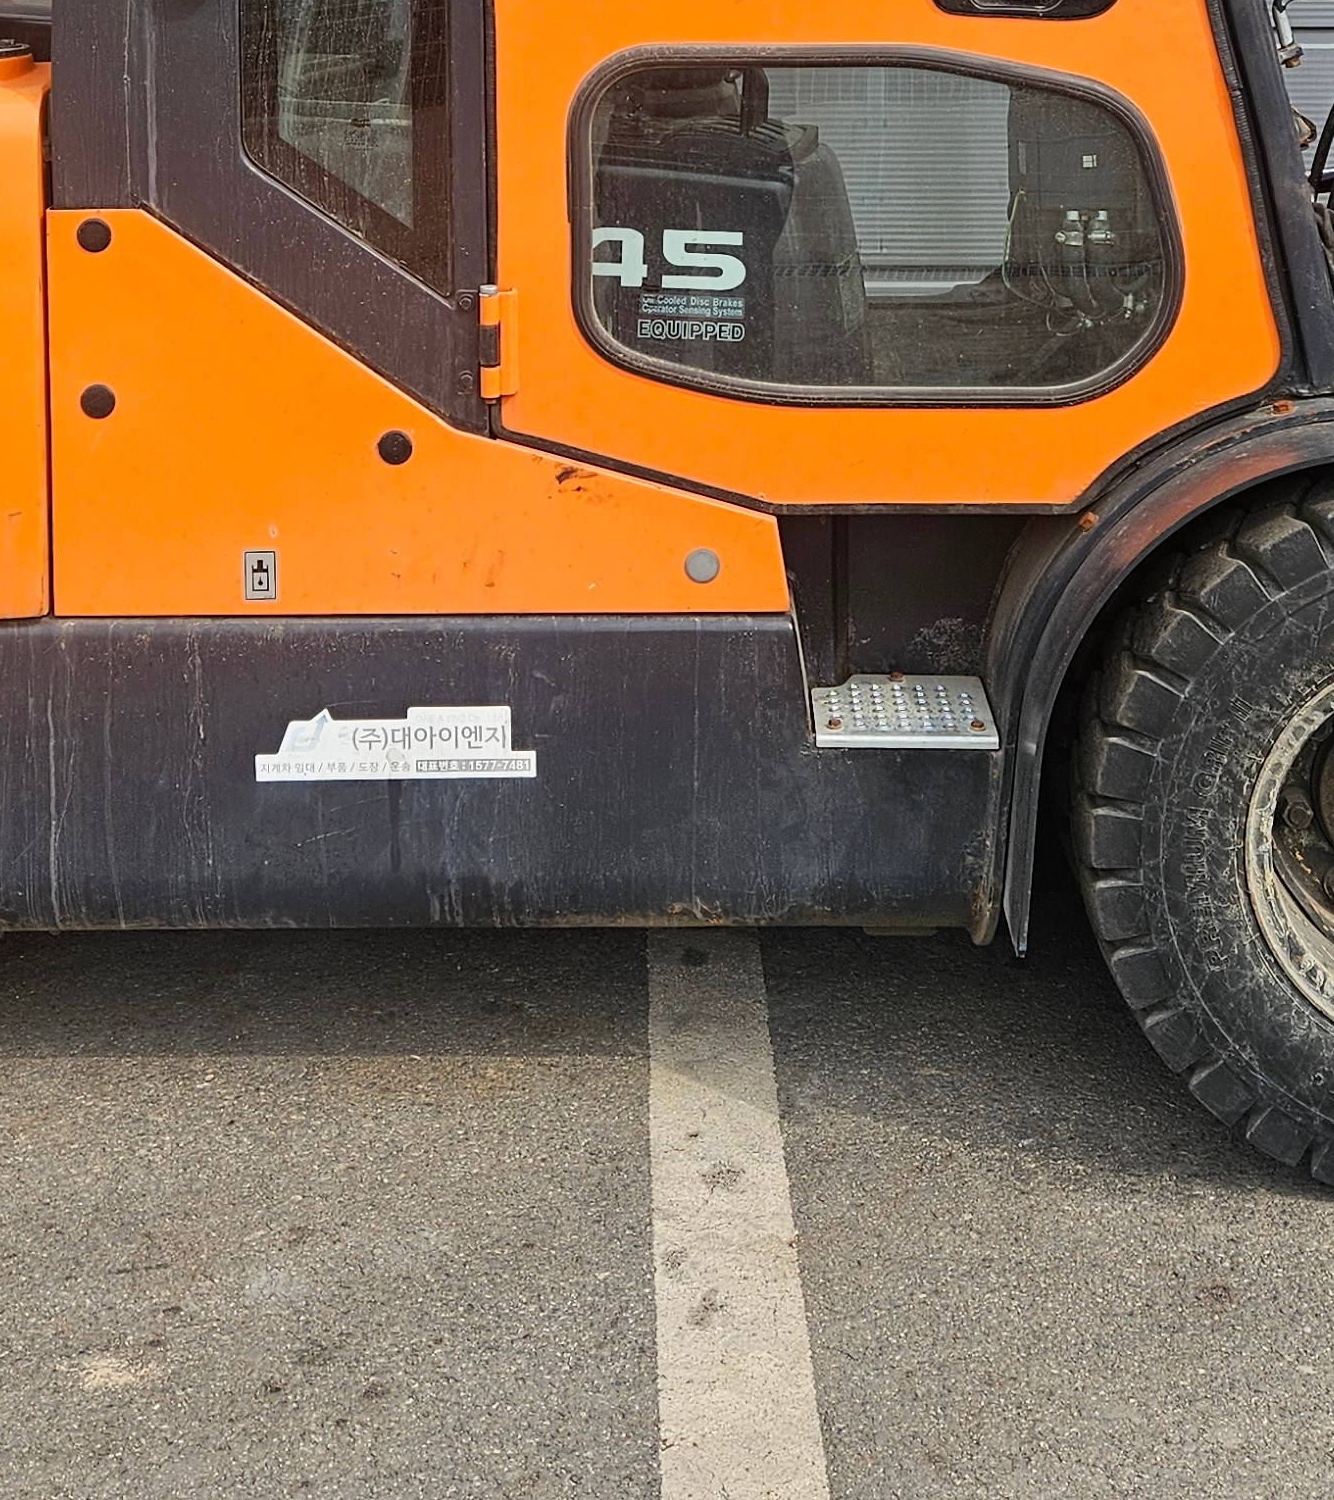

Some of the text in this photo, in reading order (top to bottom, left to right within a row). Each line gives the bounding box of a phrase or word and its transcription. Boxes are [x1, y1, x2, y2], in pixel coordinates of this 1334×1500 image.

[592, 226, 747, 291] 45
[657, 295, 687, 305] Cooled
[690, 296, 709, 306] Disc
[712, 297, 743, 308] Brakes
[679, 305, 711, 317] Sensing
[712, 306, 743, 318] System
[637, 319, 745, 342] EQUIPPED
[352, 725, 507, 751] (주)대아이엔지
[260, 762, 292, 774] 지게차
[294, 762, 315, 774] 임대
[358, 761, 379, 773] 도장
[468, 759, 531, 771] 1577-7481
